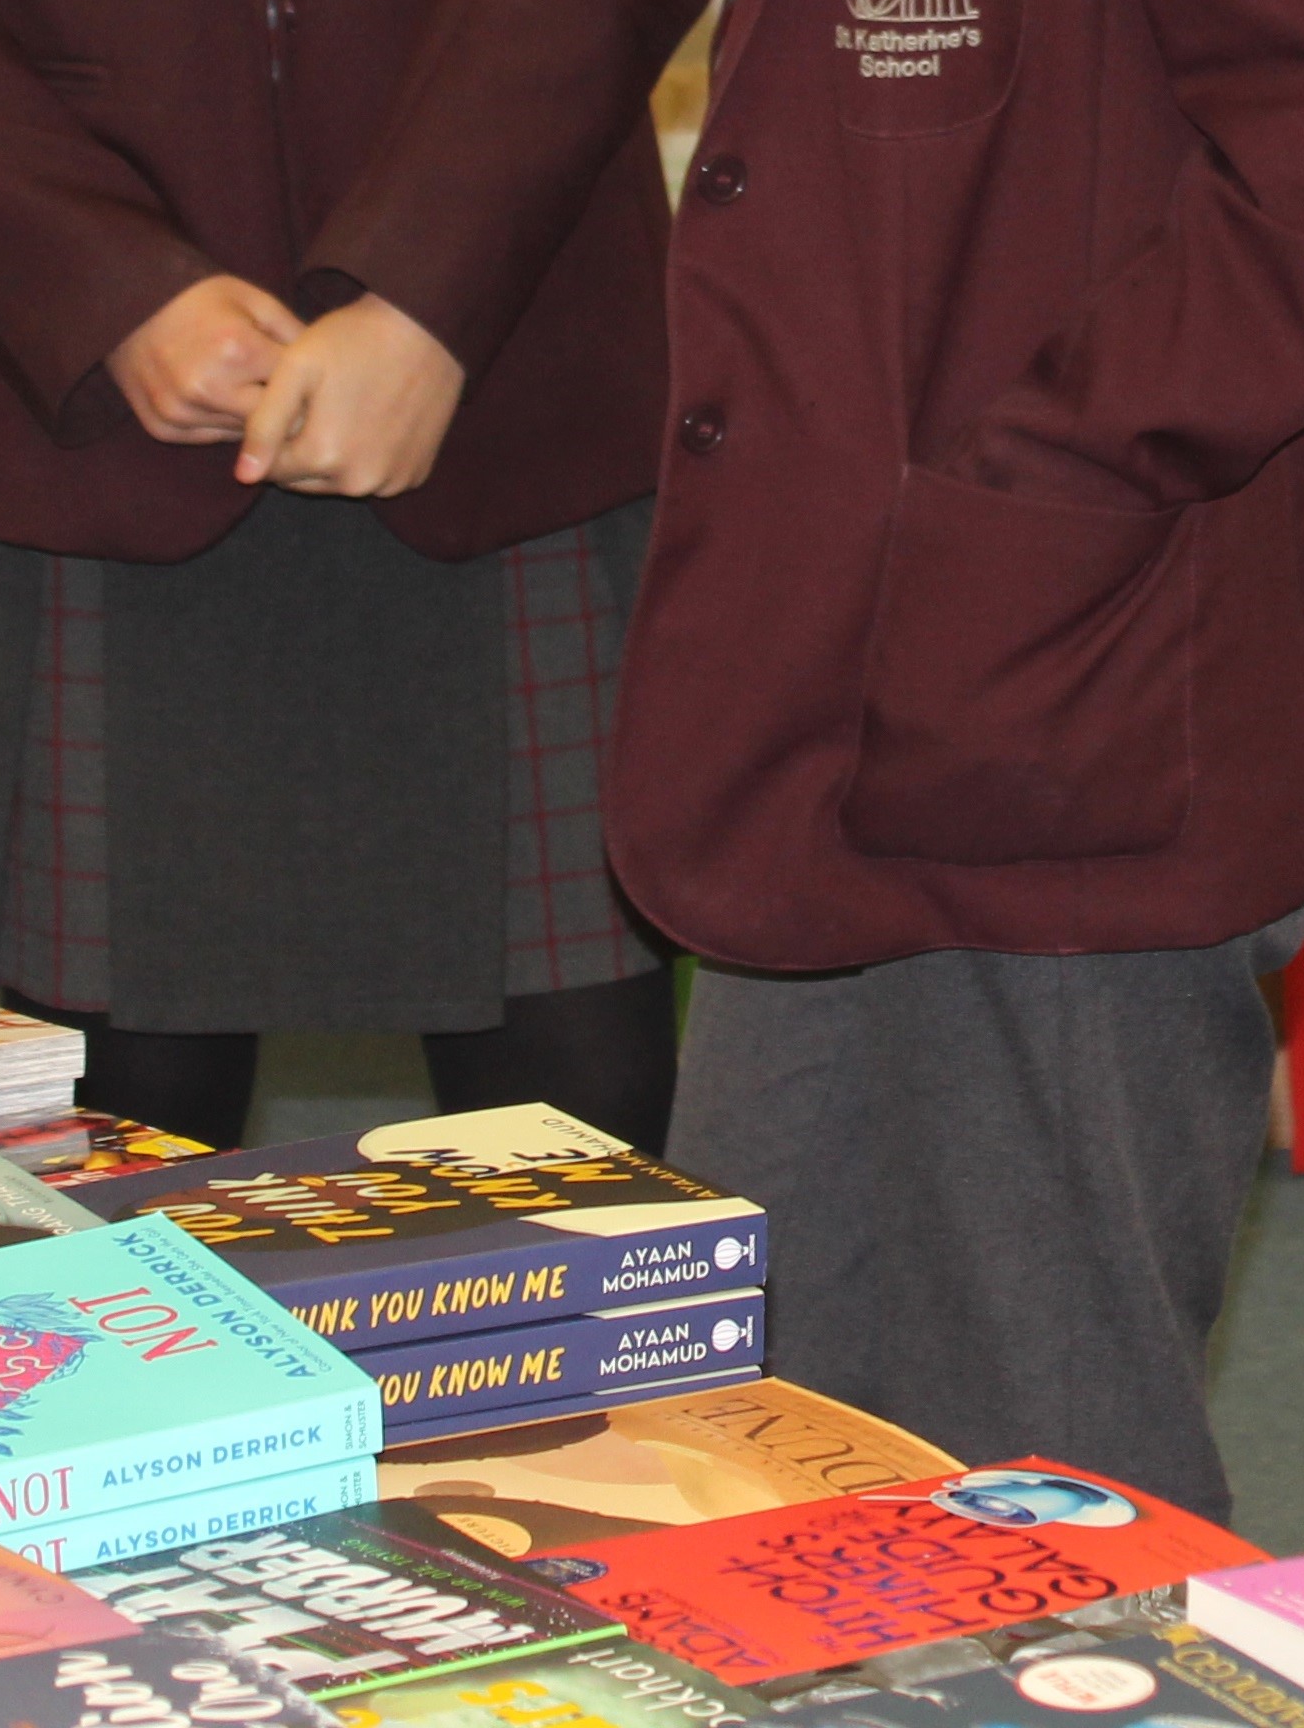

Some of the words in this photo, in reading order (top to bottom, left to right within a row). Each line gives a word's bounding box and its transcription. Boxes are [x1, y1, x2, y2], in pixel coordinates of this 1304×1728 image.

[854, 26, 982, 53] Katherine's
[859, 54, 941, 79] School
[534, 1116, 654, 1166] MOHAMUD
[202, 1170, 398, 1243] THINK
[321, 1169, 461, 1214] YOU
[385, 1146, 575, 1211] KNOW
[635, 1166, 721, 1198] AYAAN
[21, 1206, 74, 1236] RANG
[109, 1233, 221, 1308] DERRICK
[603, 1261, 710, 1294] MOHAMUD
[620, 1241, 693, 1269] AYAAN
[64, 1282, 224, 1363] NOT
[293, 1300, 359, 1335] HINK
[371, 1285, 424, 1326] YOU
[432, 1273, 516, 1316] KNOW
[522, 1265, 568, 1302] ME
[210, 1305, 317, 1380] ALYSON
[601, 1343, 706, 1375] MOHAMUD
[618, 1323, 690, 1351] AYAAN
[428, 1355, 514, 1399] KNOW
[519, 1347, 565, 1384] ME
[102, 1452, 201, 1488] ALYSON
[213, 1425, 322, 1464] DERRICK
[677, 1393, 917, 1491] DUNE
[97, 1523, 196, 1559] ALYSON
[208, 1497, 317, 1536] DERRICK
[168, 1529, 535, 1657] MURDER
[754, 1529, 992, 1634] HIKER'S
[841, 1525, 1063, 1618] GUIDE
[604, 1589, 771, 1674] ADAMS
[171, 1661, 283, 1721] One
